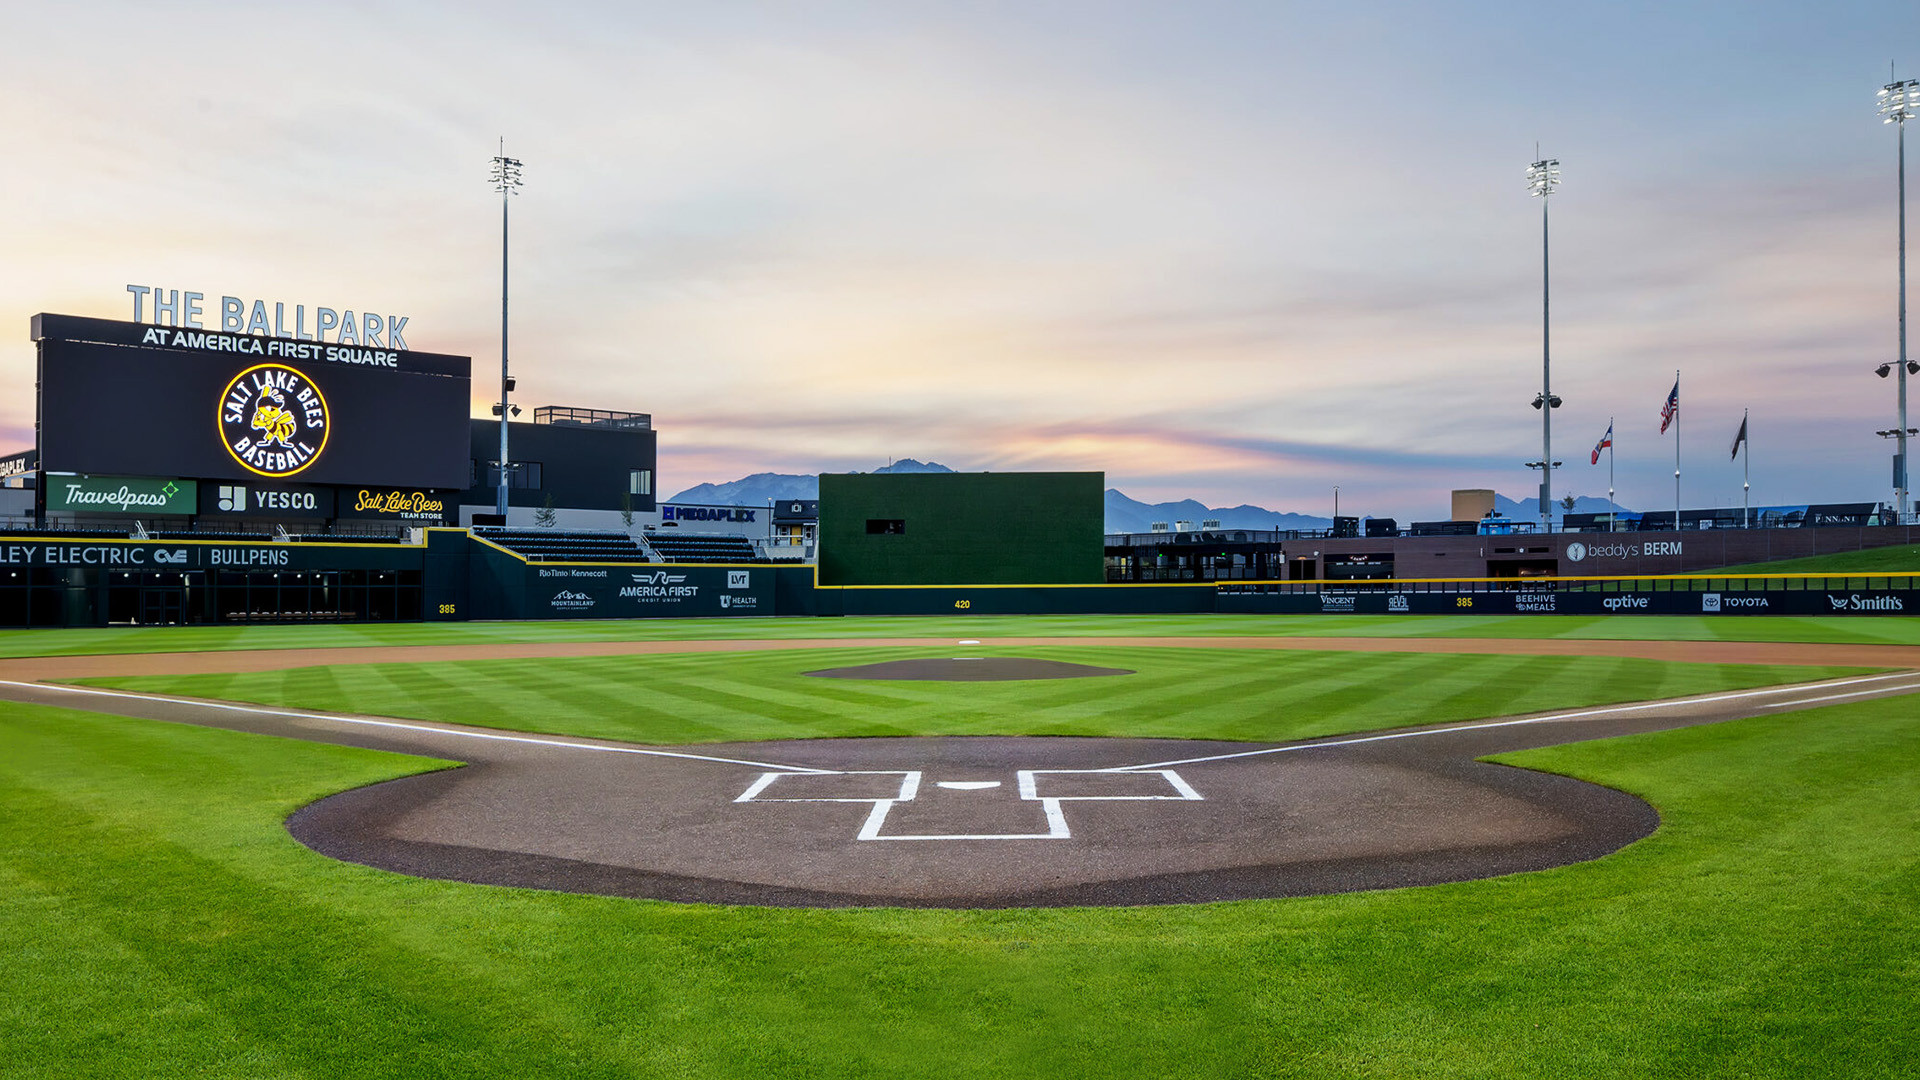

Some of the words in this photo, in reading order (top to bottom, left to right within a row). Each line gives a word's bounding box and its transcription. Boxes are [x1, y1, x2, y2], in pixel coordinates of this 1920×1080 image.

[127, 284, 203, 329] THE
[221, 295, 409, 351] BALLPARK
[142, 327, 171, 345] AT
[171, 331, 264, 355] AMERICA
[267, 340, 323, 360] FIRST
[326, 346, 398, 367] SQUARE
[224, 381, 252, 423] SALT
[252, 370, 298, 393] LAKE
[296, 387, 324, 428] BEES
[233, 436, 315, 470] BASEBALL
[65, 484, 167, 511] Travelpass
[355, 489, 384, 511] Salt
[379, 491, 413, 513] Lake
[411, 491, 443, 513] Bees
[676, 507, 756, 522] MEGAPLEX
[45, 546, 145, 564] ELECTRIC
[211, 549, 289, 565] BULLPENS
[1588, 543, 1639, 560] beddy's
[1643, 541, 1682, 556] BERM
[571, 569, 607, 577] Kennecott
[731, 574, 747, 585] LVT
[619, 586, 667, 597] AMERICA
[668, 586, 699, 597] FIRST
[1515, 594, 1556, 603] BEEHIVE
[439, 604, 455, 614] 385
[954, 599, 970, 609] 420
[1456, 597, 1473, 607] 385
[1526, 603, 1556, 611] MEALS
[1603, 594, 1648, 611] aptive
[1724, 597, 1769, 607] TOYOTA
[1850, 594, 1904, 610] Smith's
